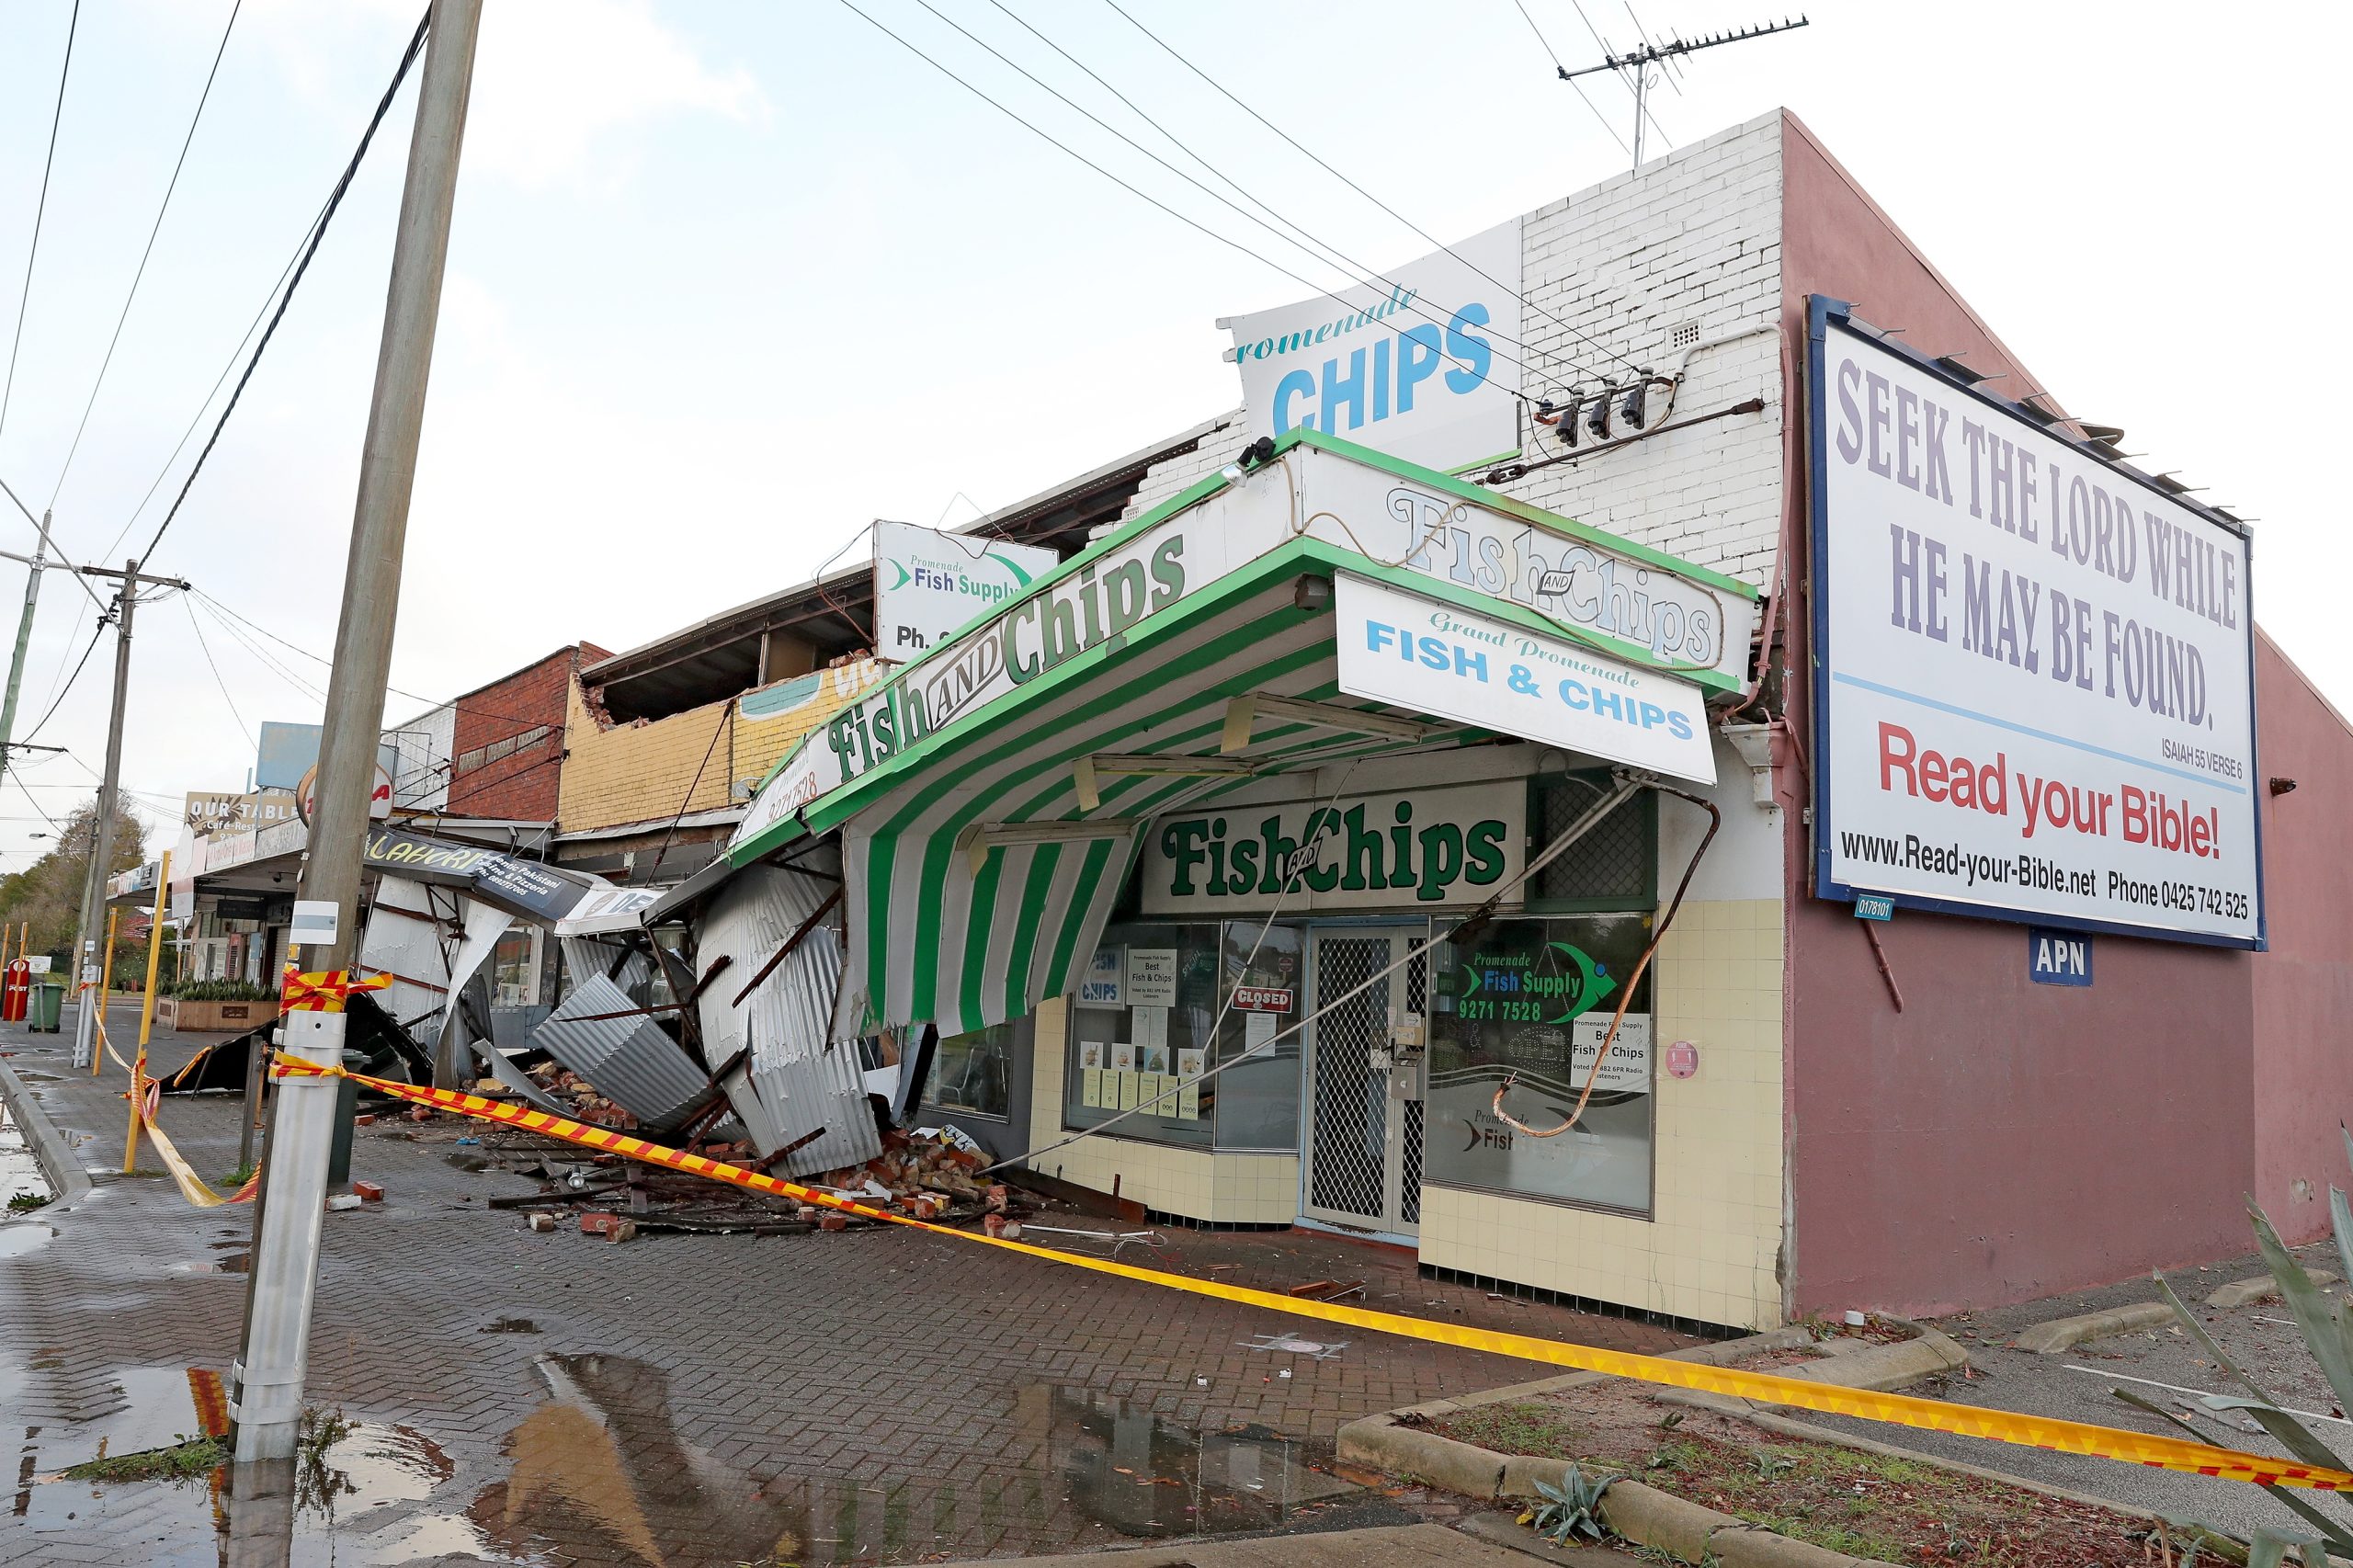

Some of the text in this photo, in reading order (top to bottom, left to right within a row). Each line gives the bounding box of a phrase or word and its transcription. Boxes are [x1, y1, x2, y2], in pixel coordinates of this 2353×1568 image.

[1272, 302, 1492, 437] CHIPS
[1836, 358, 2237, 631] SEEK THE LORD WHILE
[910, 555, 964, 574] Promenade
[915, 567, 954, 591] Fish
[1386, 488, 1711, 665] Fish AND Chips
[896, 625, 930, 650] Ph.
[1890, 523, 2213, 732] HE MAY BE FOUND.
[828, 676, 931, 784] Fish
[936, 635, 998, 724] AND
[1003, 534, 1186, 684] Chips
[1427, 612, 1640, 688] Grand Promenade
[1366, 619, 1693, 740] FISH & CHIPS
[2162, 738, 2243, 780] ISAIAH 55 VERSE 6
[1878, 722, 2221, 860] Read your Bible!
[191, 801, 231, 817] OUR
[369, 835, 481, 870] LAHORI
[1161, 815, 1302, 897] Fish
[1303, 801, 1507, 902] Chips
[513, 876, 549, 896] Pizzeria
[517, 867, 562, 889] Pakistani
[1840, 830, 2249, 920] www.Read-your-Bible.net Phone 0425 742 525
[1859, 898, 1891, 917] 0178101
[1473, 952, 1530, 967] Promenade
[2035, 938, 2086, 976] APN
[1132, 973, 1145, 982] Fish
[1154, 974, 1172, 983] Chips
[1484, 971, 1581, 998] Fish Supply
[1237, 990, 1289, 1005] CLOSED
[1460, 1000, 1540, 1021] 9271 7528
[1573, 1045, 1596, 1055] Fish
[1611, 1047, 1644, 1060] Chips
